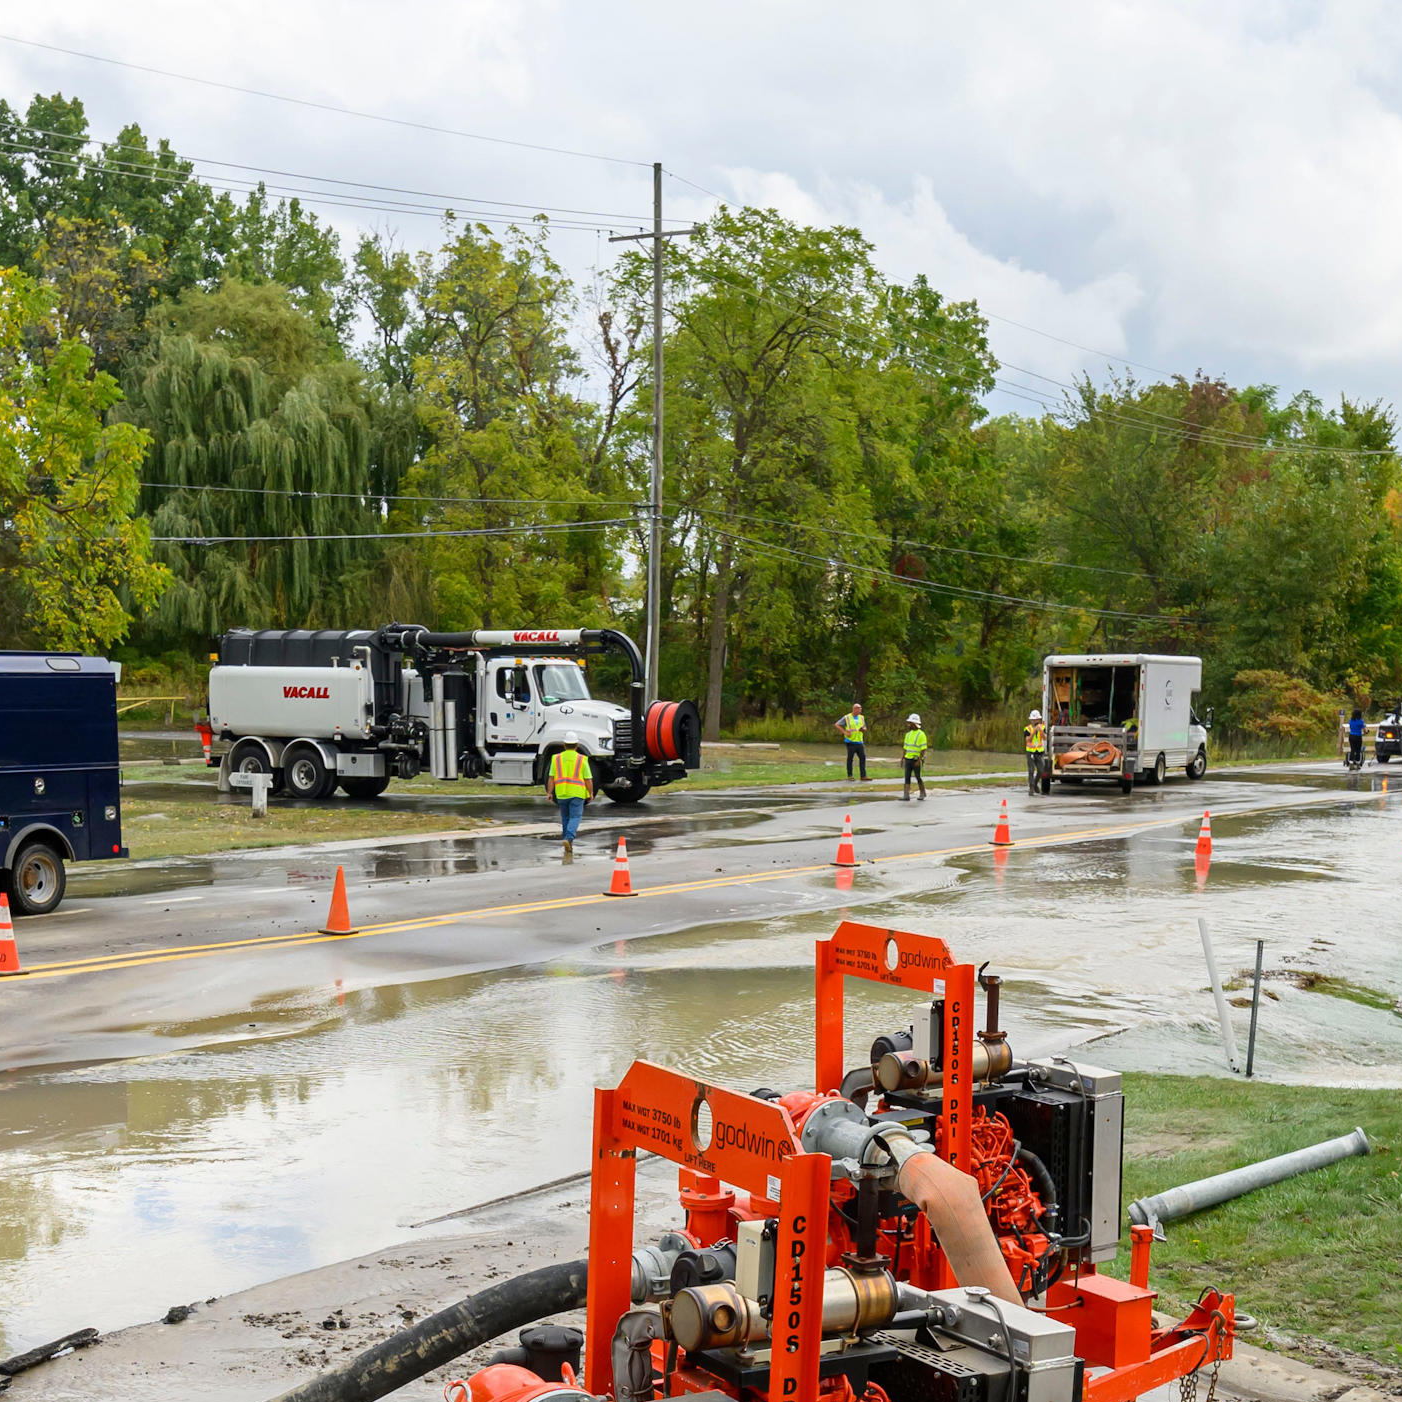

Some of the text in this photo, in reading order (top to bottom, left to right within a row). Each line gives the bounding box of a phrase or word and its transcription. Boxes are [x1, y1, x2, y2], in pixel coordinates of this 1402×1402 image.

[514, 631, 559, 642] VACALL
[283, 686, 330, 699] VACALL
[857, 949, 871, 959] 3750
[900, 950, 941, 971] godwin
[857, 960, 871, 970] 1701
[622, 1100, 681, 1129] MAX WGT 3750 lb
[950, 1099, 959, 1138] DRI
[622, 1118, 683, 1151] MAX WGT 1701 kg
[716, 1120, 776, 1161] godwin
[684, 1152, 716, 1173] LIFT HERE
[785, 1215, 807, 1354] CD150S
